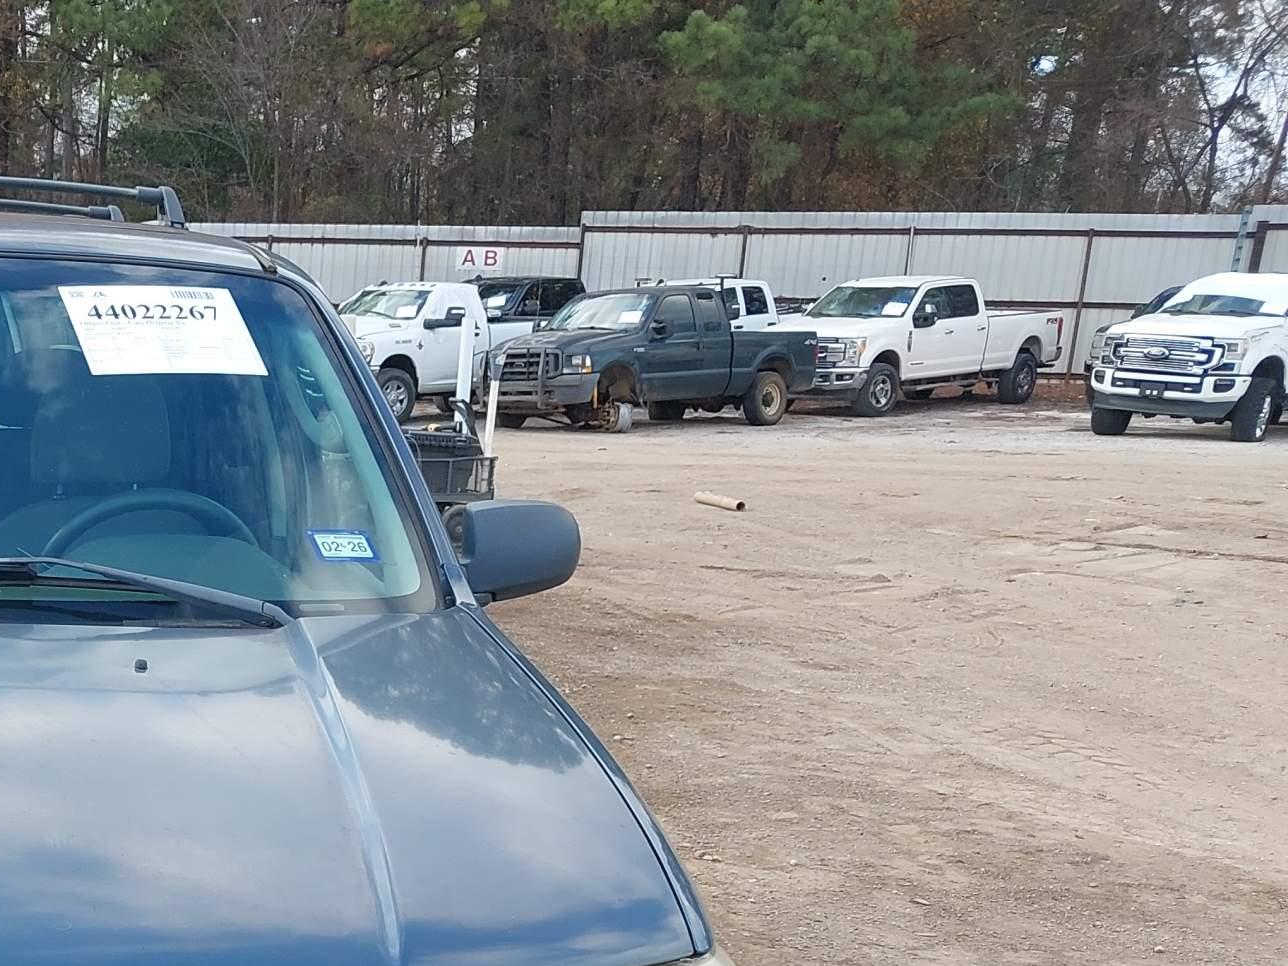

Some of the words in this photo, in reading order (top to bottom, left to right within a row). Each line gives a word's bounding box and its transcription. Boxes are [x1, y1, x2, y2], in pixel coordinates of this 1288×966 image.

[461, 249, 476, 266] A
[484, 250, 498, 267] B
[87, 303, 217, 321] 44022267
